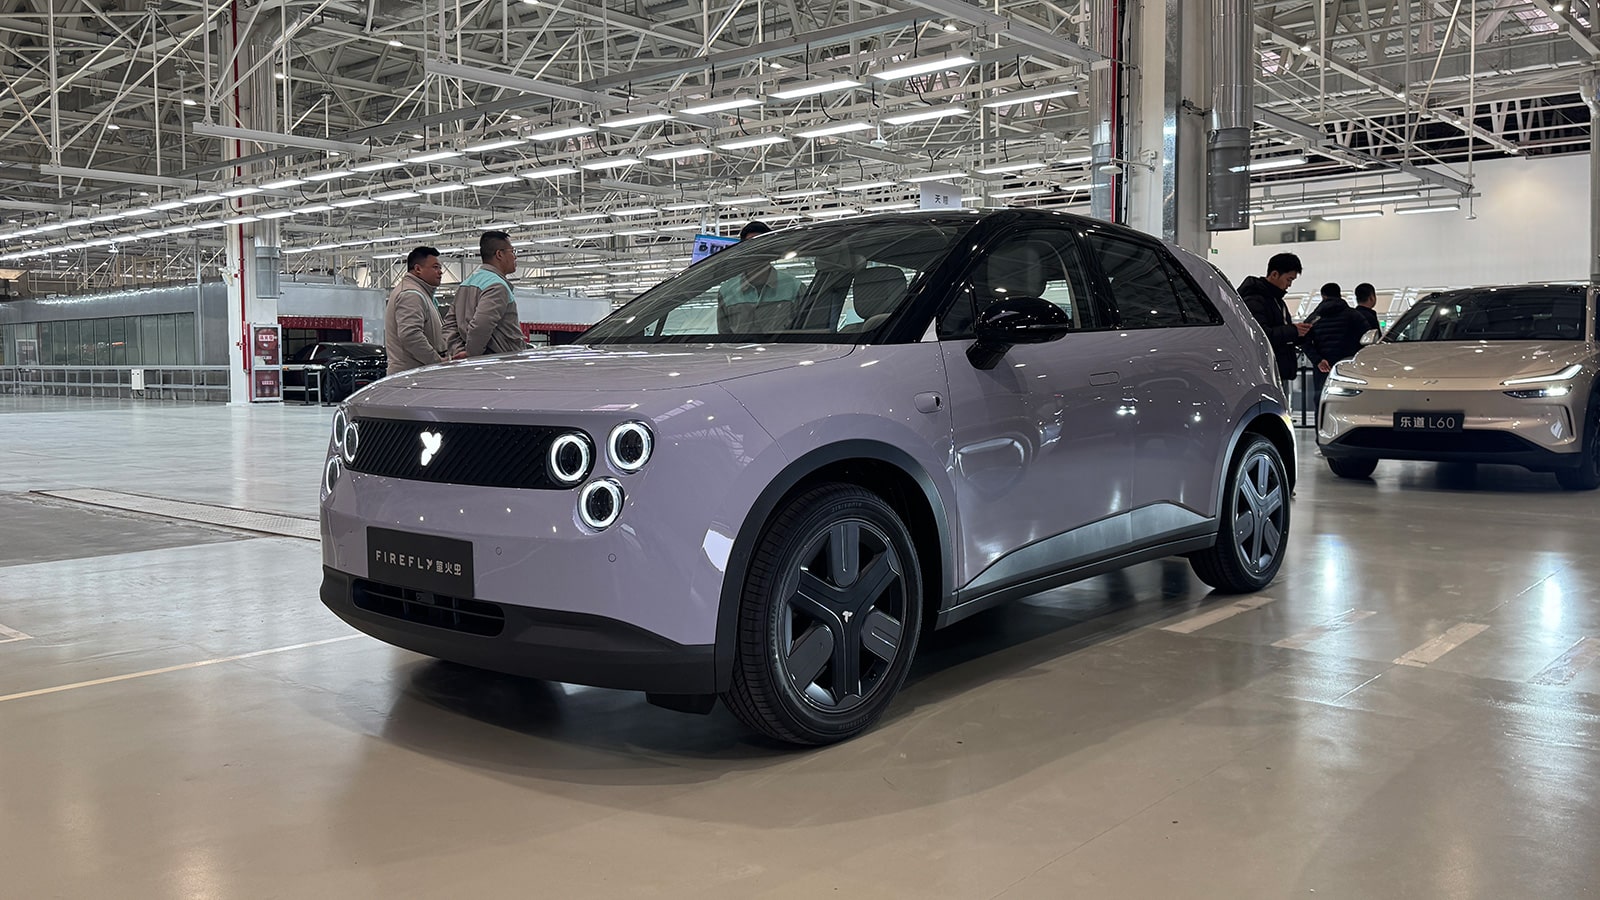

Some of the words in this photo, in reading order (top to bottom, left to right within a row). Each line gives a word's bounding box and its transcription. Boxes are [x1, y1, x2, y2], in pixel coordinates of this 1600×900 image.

[1400, 416, 1425, 428] 乐道
[1429, 417, 1455, 429] L60
[375, 550, 433, 570] FIREFLY
[436, 560, 462, 576] 萤火虫
